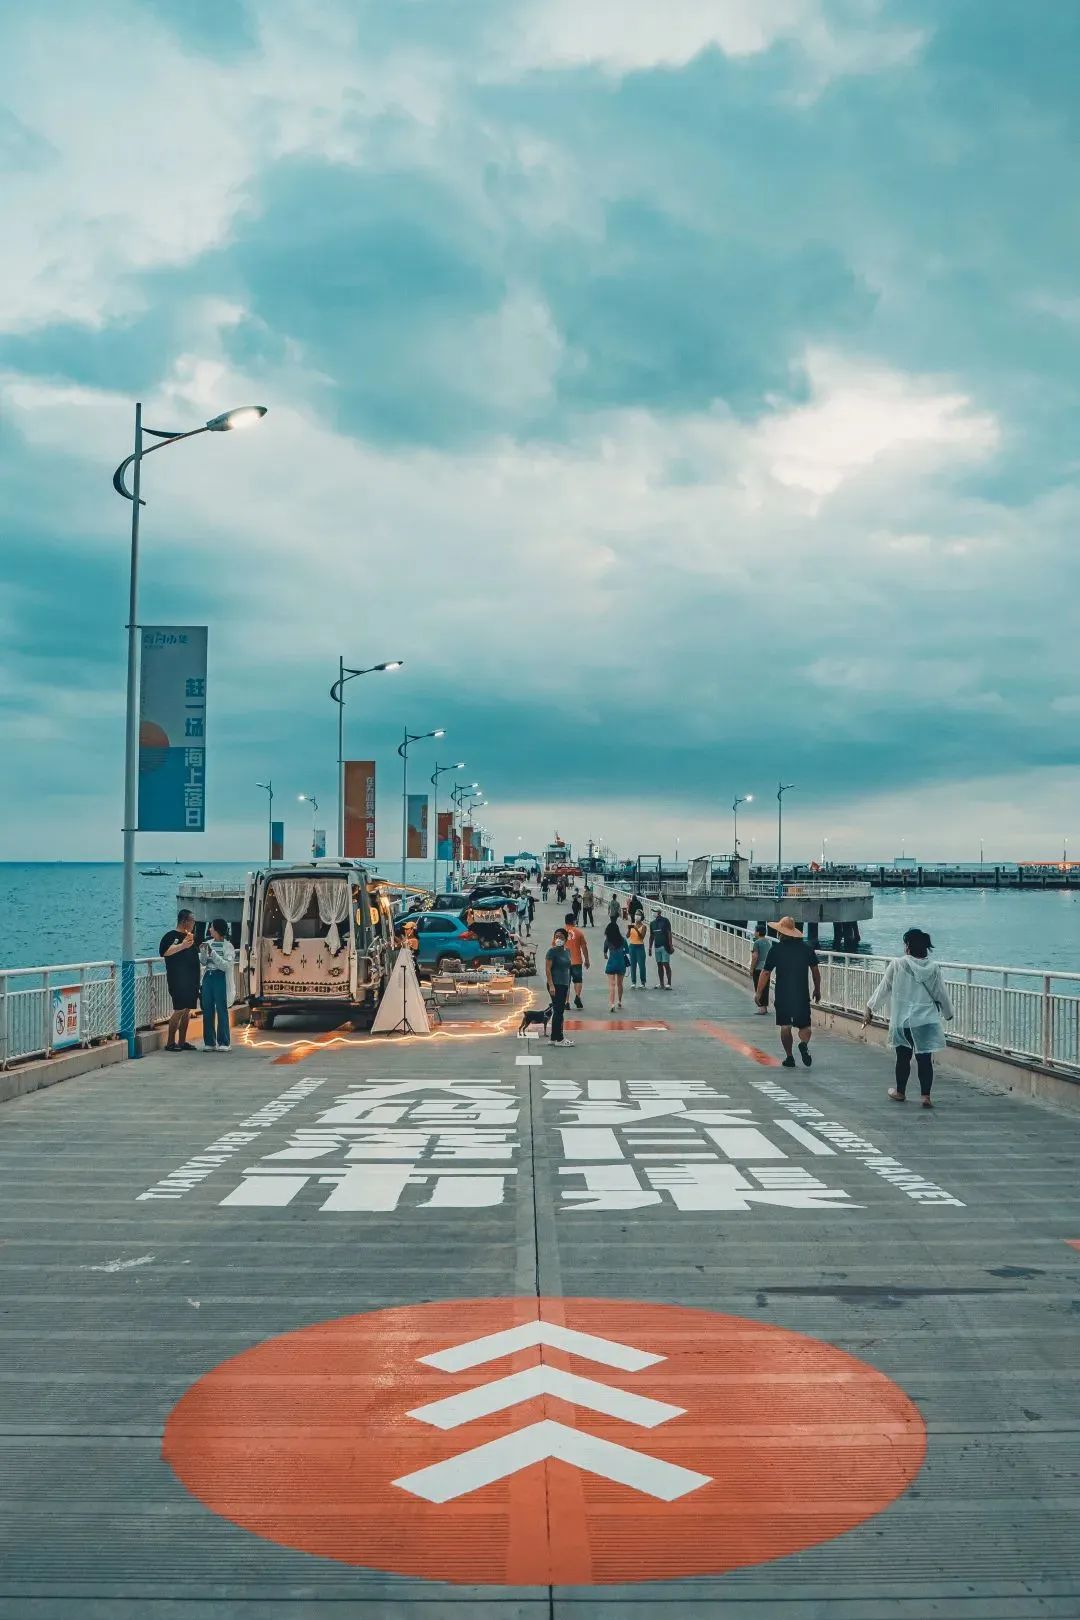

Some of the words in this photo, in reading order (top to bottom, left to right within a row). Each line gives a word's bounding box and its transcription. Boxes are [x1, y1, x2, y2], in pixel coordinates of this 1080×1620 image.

[334, 1079, 731, 1099] 天涯
[315, 1099, 761, 1124] 码头
[135, 1155, 233, 1200] TIANYA
[204, 1132, 262, 1151] PIER
[239, 1100, 299, 1127] SUNSET
[260, 1127, 788, 1160] 落日
[779, 1103, 824, 1117] PIER
[806, 1121, 882, 1154] SUNSET
[856, 1157, 967, 1206] MARKET
